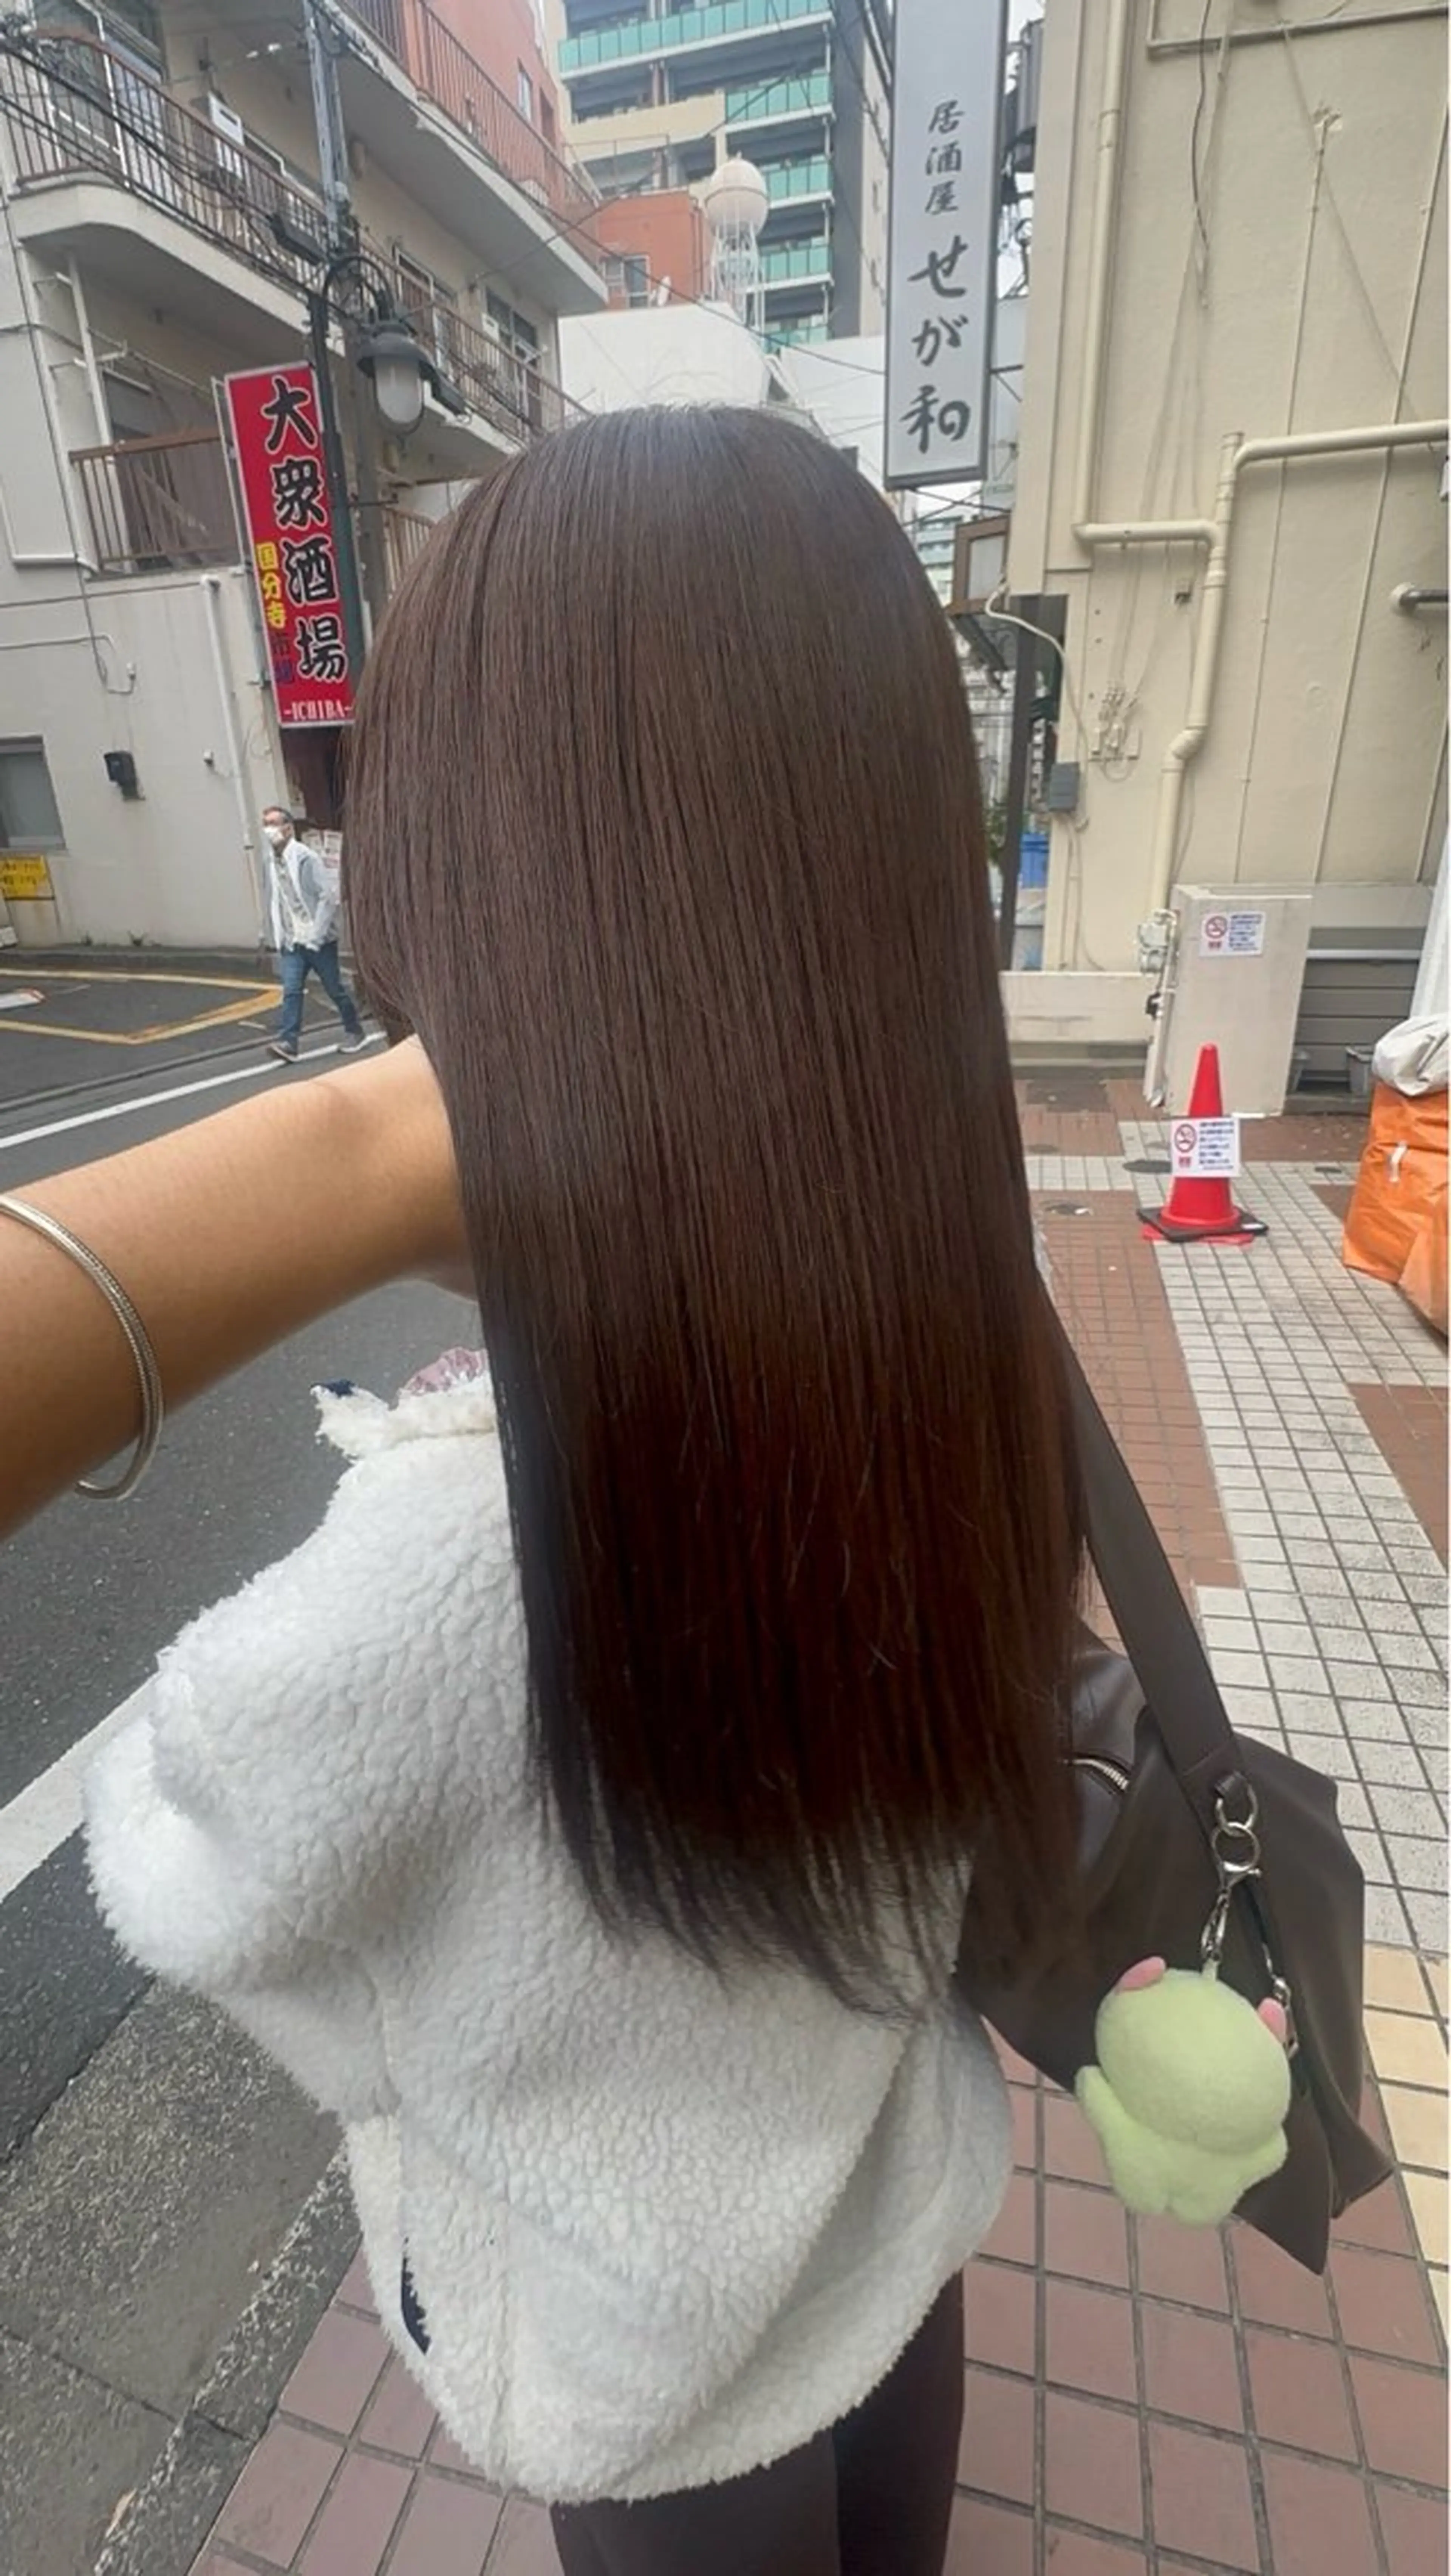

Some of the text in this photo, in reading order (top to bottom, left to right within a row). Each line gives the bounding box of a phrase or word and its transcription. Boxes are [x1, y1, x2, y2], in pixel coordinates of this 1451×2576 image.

[900, 100, 971, 454] 居酒屋 せが和
[261, 376, 348, 683] 大衆酒場
